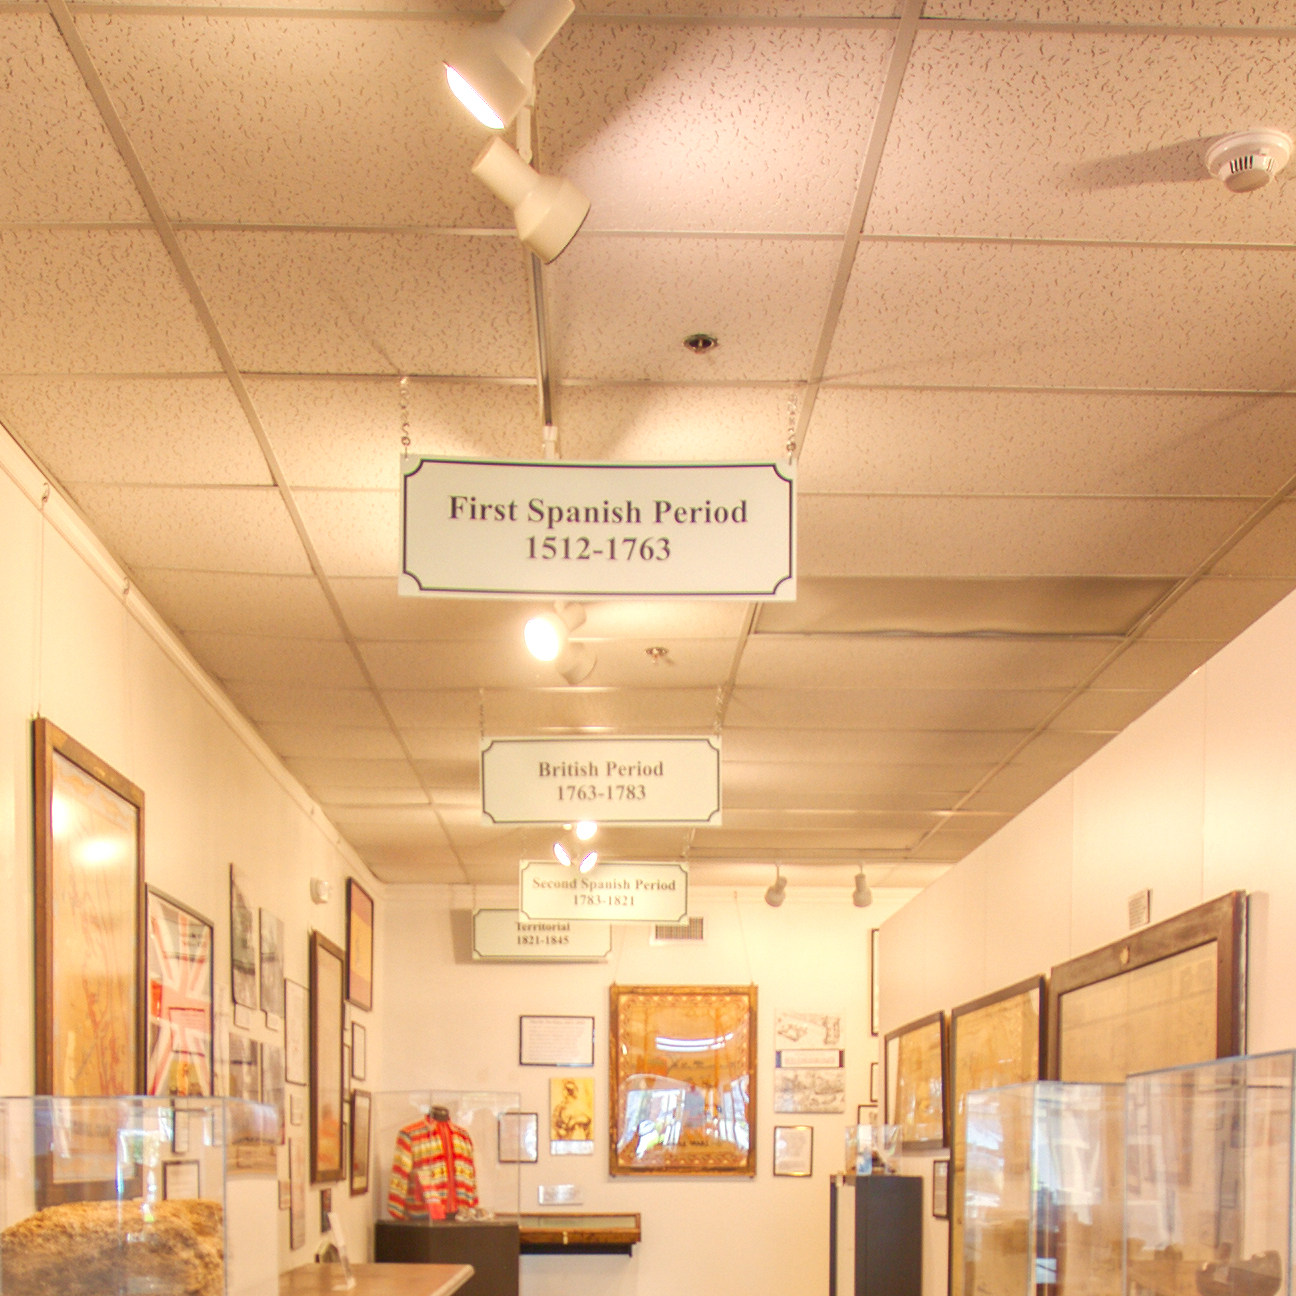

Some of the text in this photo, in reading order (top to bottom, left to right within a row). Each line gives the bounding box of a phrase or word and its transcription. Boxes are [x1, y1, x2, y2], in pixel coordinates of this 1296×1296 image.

[449, 495, 747, 530] First Spanish Period
[528, 535, 671, 561] 1512-1763
[538, 760, 664, 778] British Period
[558, 784, 646, 801] 1763-1783
[532, 876, 676, 892] Second Spanish Period
[573, 894, 634, 906] 1783-1821
[515, 921, 571, 932] Territorial
[516, 935, 570, 945] 1821-1845
